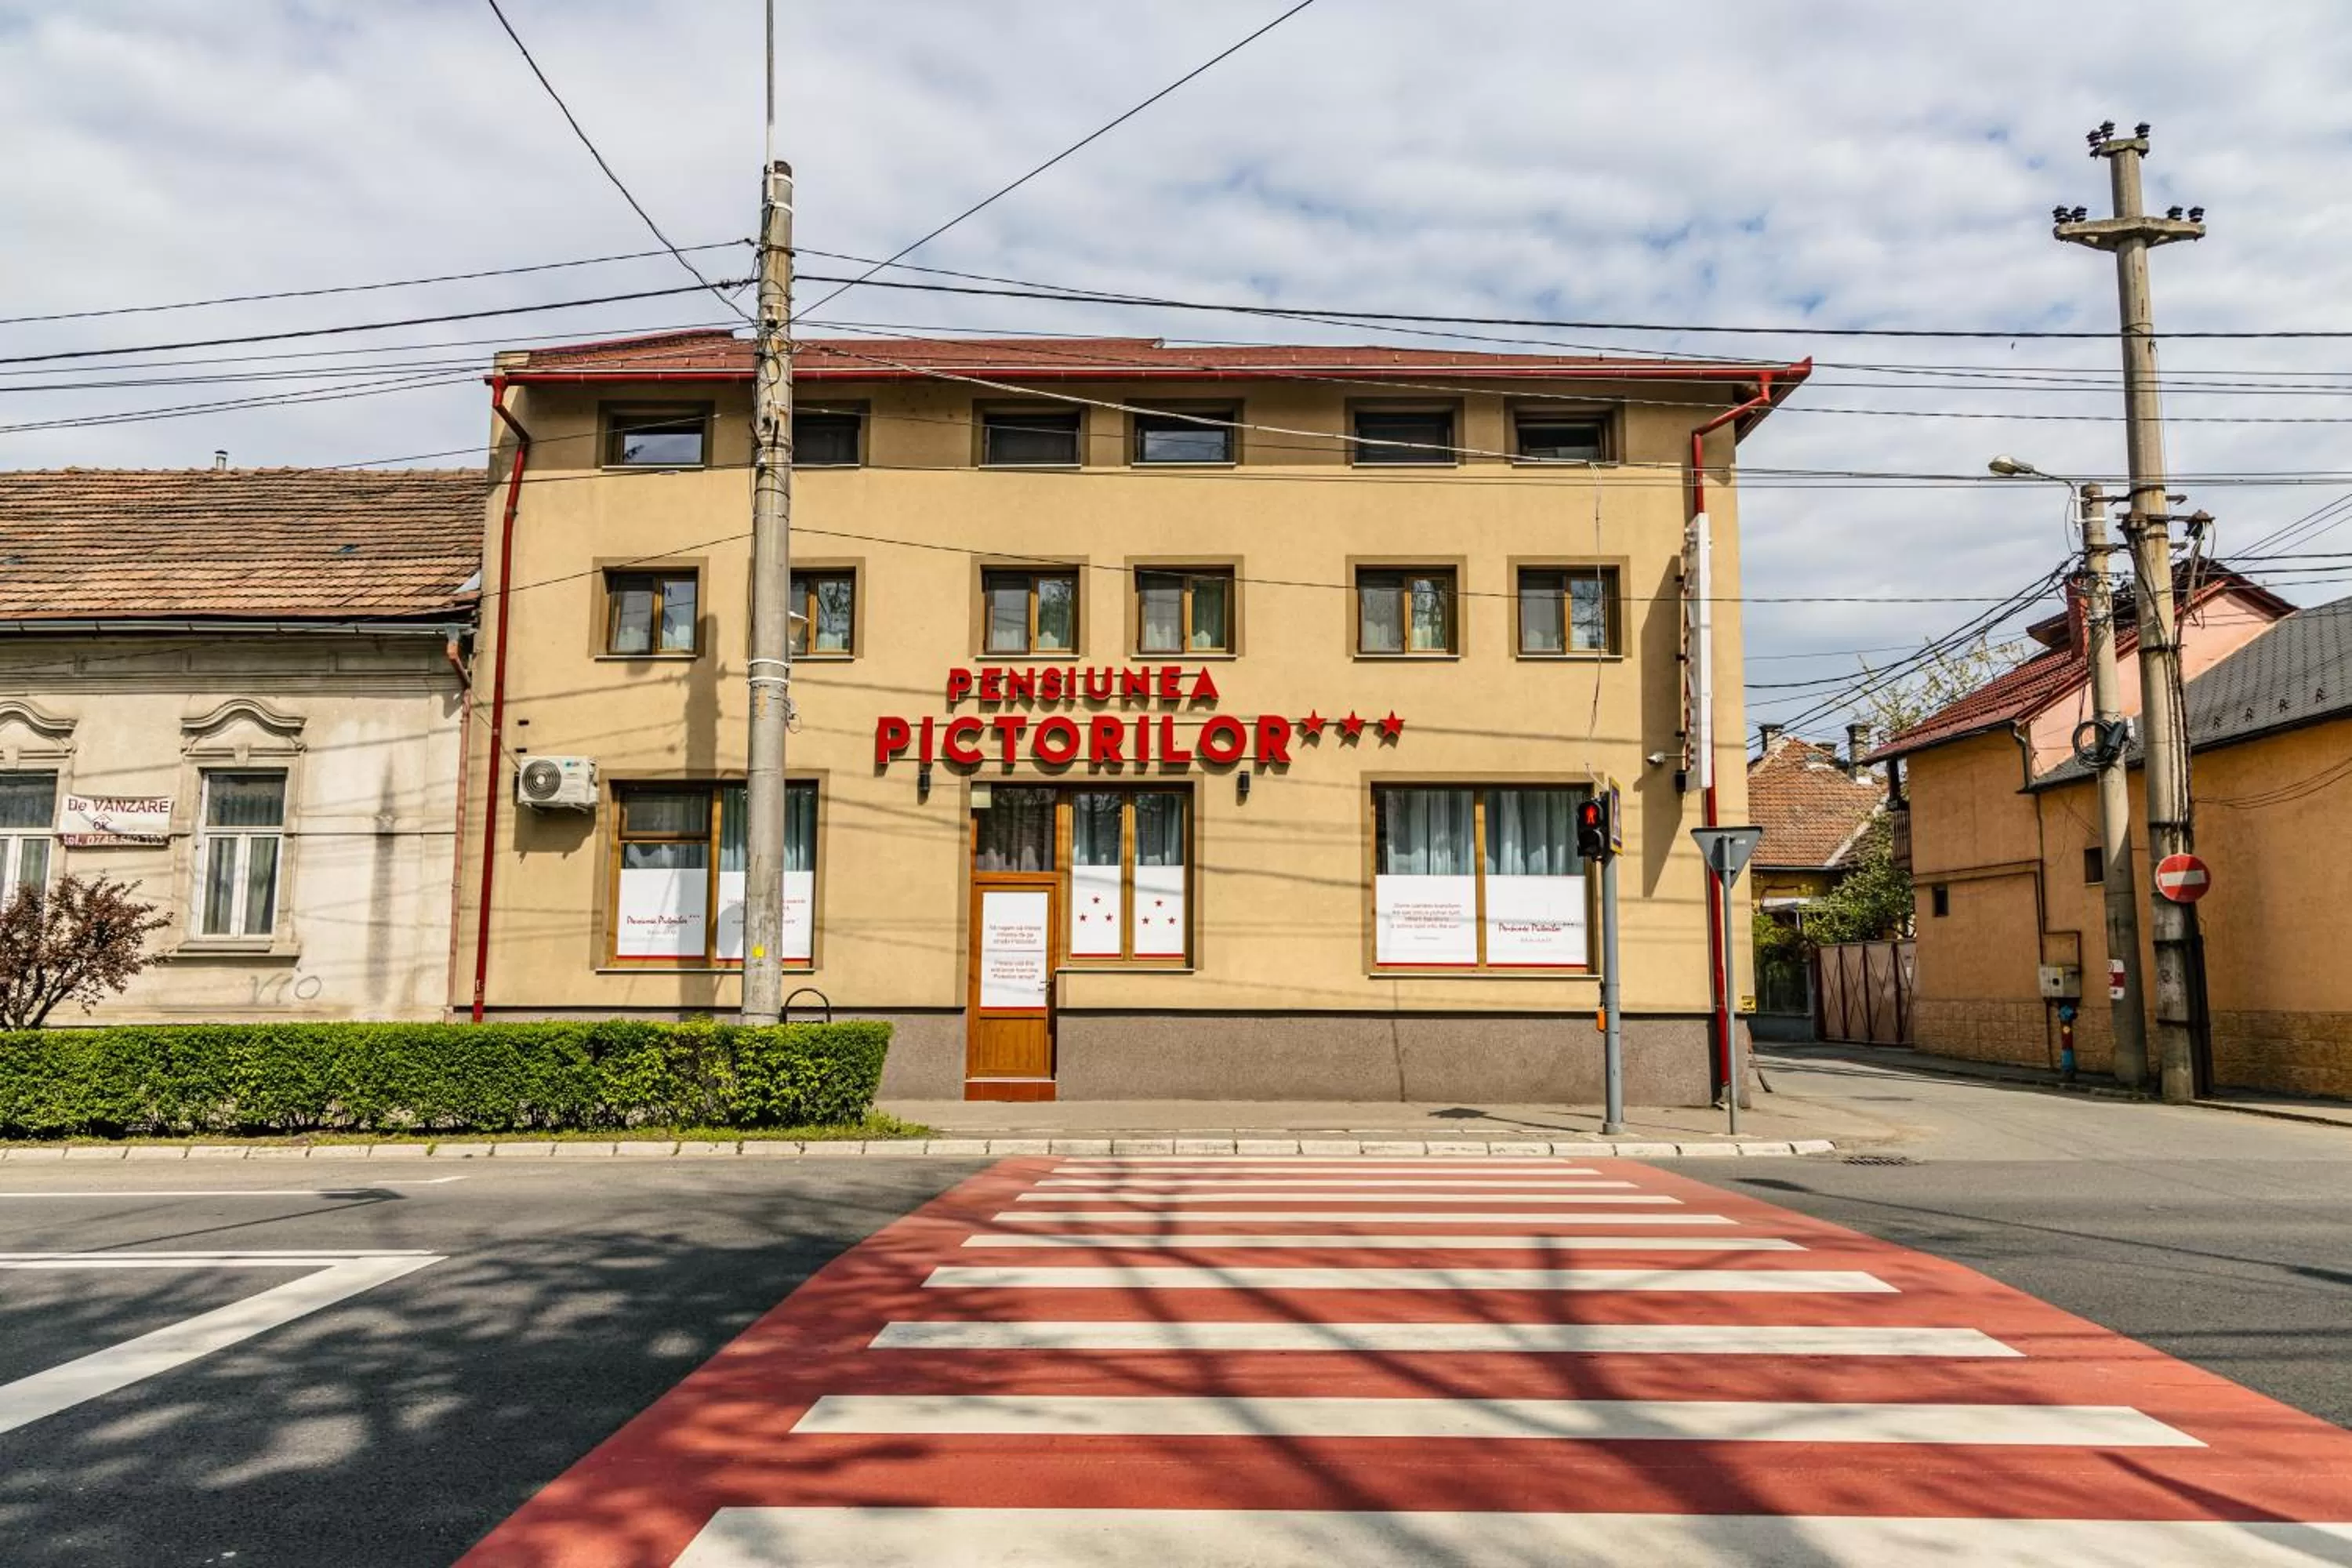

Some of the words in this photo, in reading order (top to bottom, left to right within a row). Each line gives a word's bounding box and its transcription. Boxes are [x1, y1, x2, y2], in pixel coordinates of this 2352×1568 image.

[948, 666, 1219, 702] PENSIUNEA
[877, 715, 1292, 764] PICTORILOR
[68, 797, 87, 811] De
